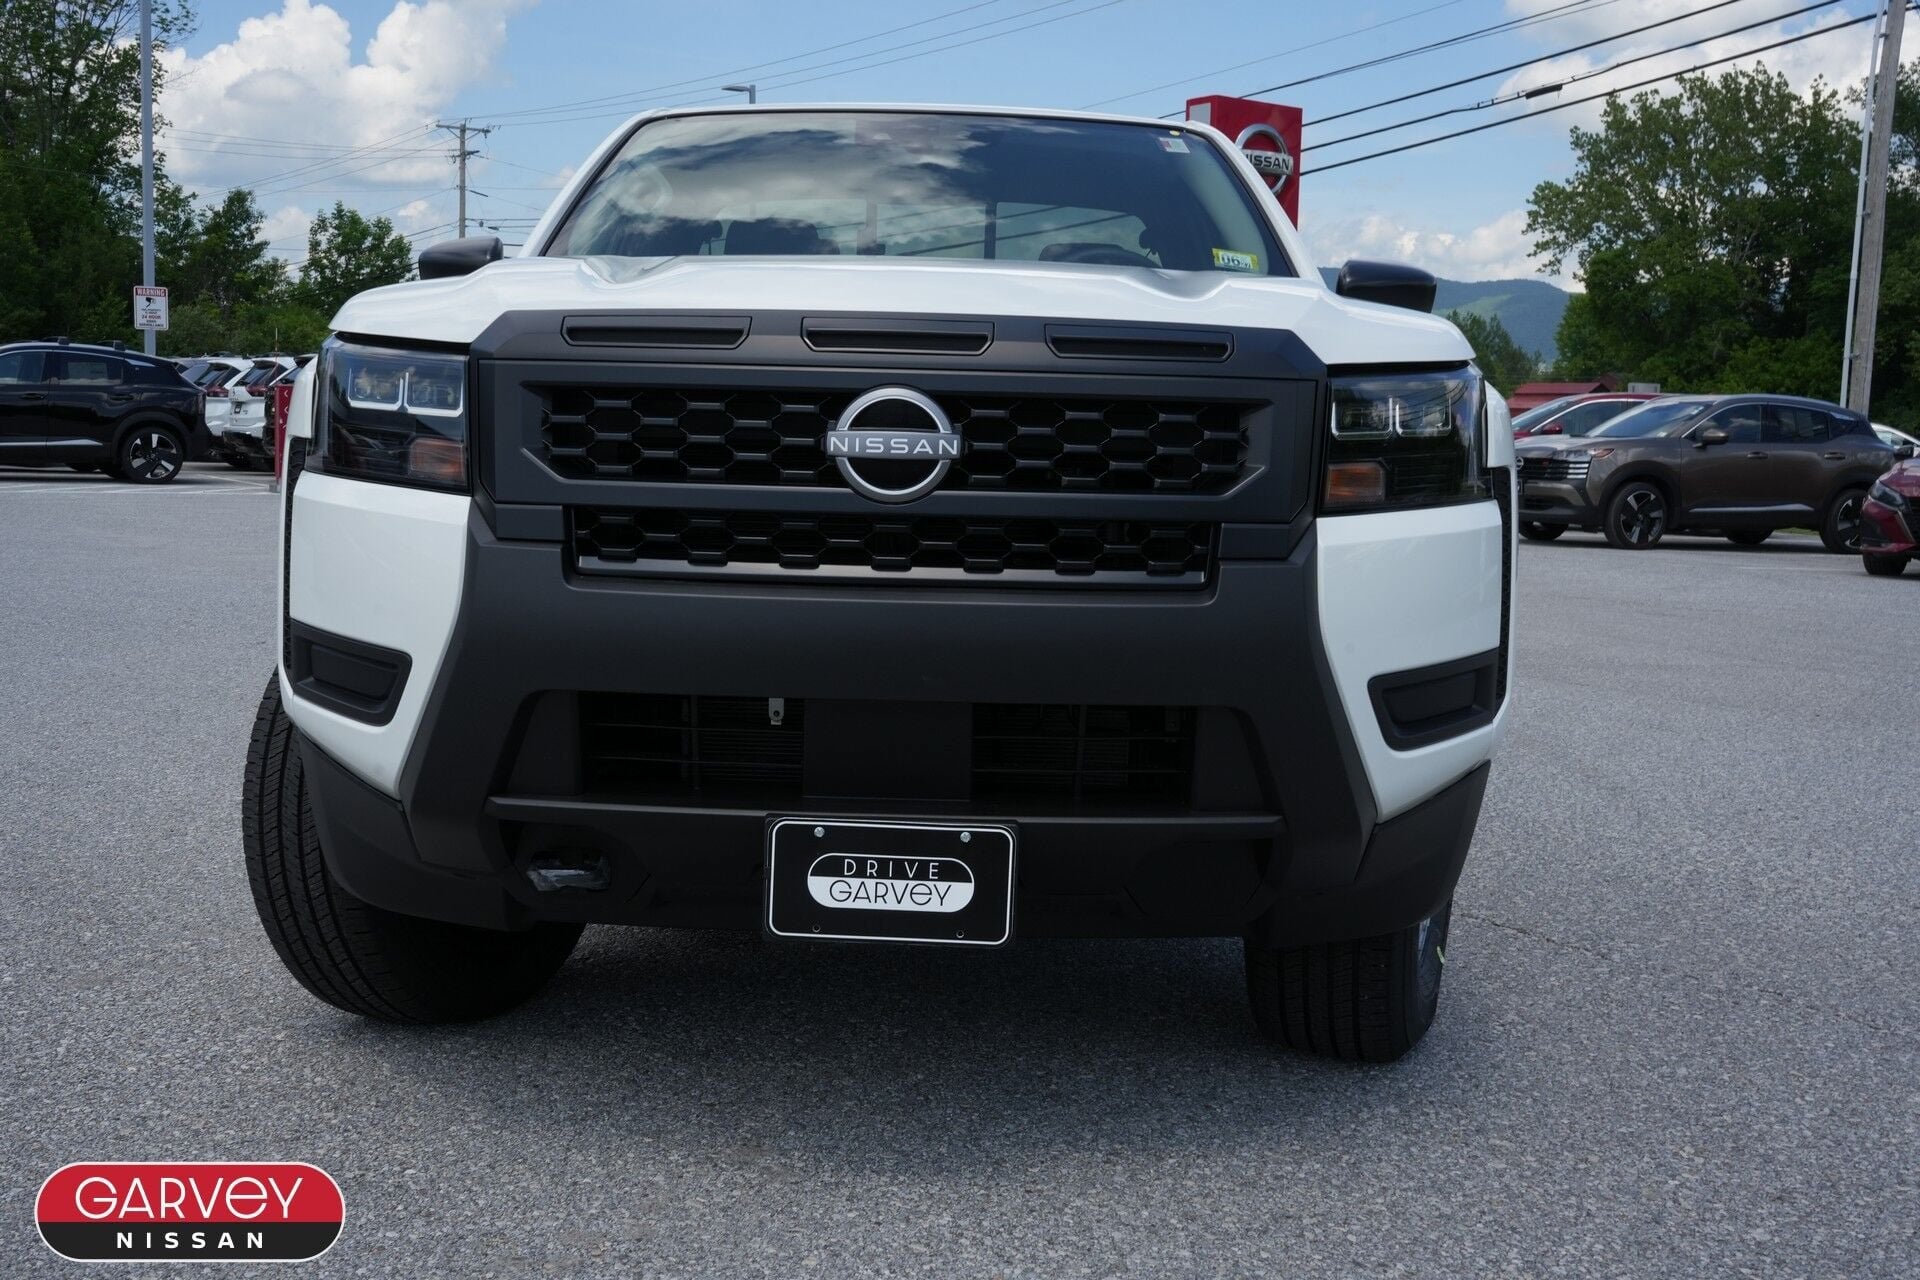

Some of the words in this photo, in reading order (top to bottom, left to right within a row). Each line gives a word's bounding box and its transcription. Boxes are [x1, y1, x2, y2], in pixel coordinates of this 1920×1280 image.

[136, 287, 165, 297] WARNING
[830, 436, 958, 455] NISSAN
[843, 858, 940, 880] DRIVE
